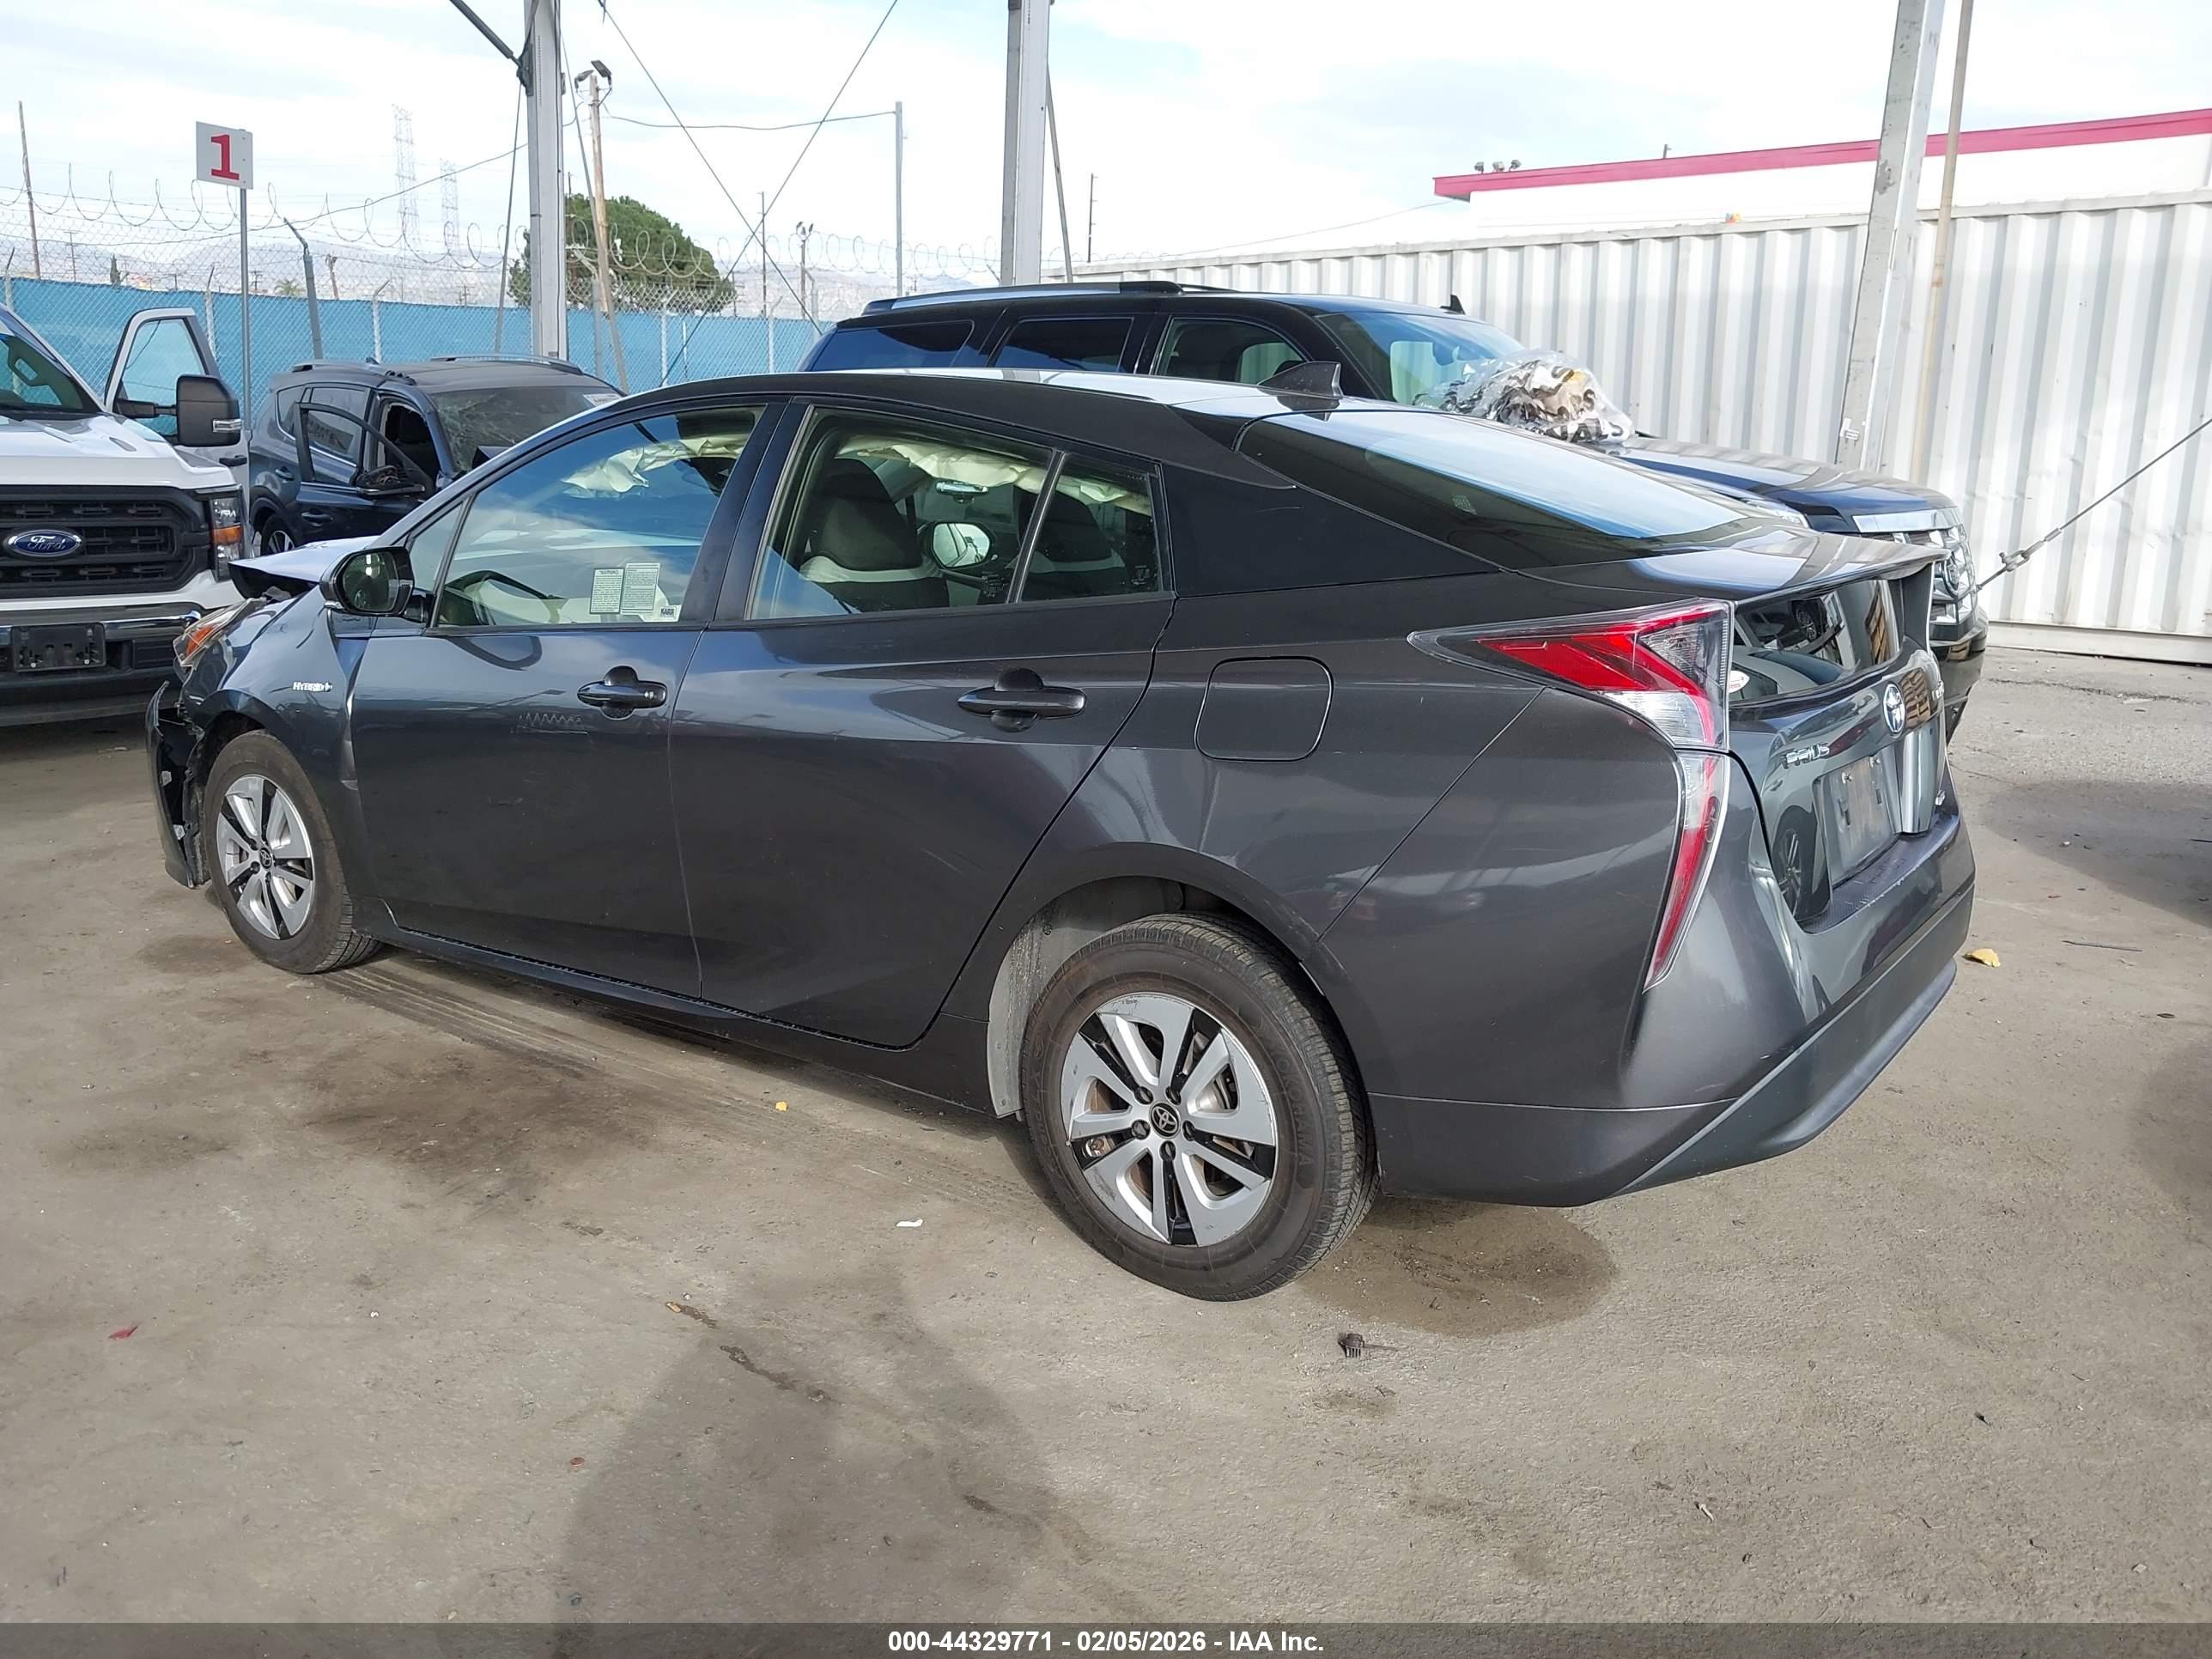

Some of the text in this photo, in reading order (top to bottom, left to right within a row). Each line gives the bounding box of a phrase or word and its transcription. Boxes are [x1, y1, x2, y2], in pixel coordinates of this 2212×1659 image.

[210, 134, 240, 181] 1
[27, 535, 66, 550] Ford
[1266, 1037, 1314, 1167] YOKOHAMA
